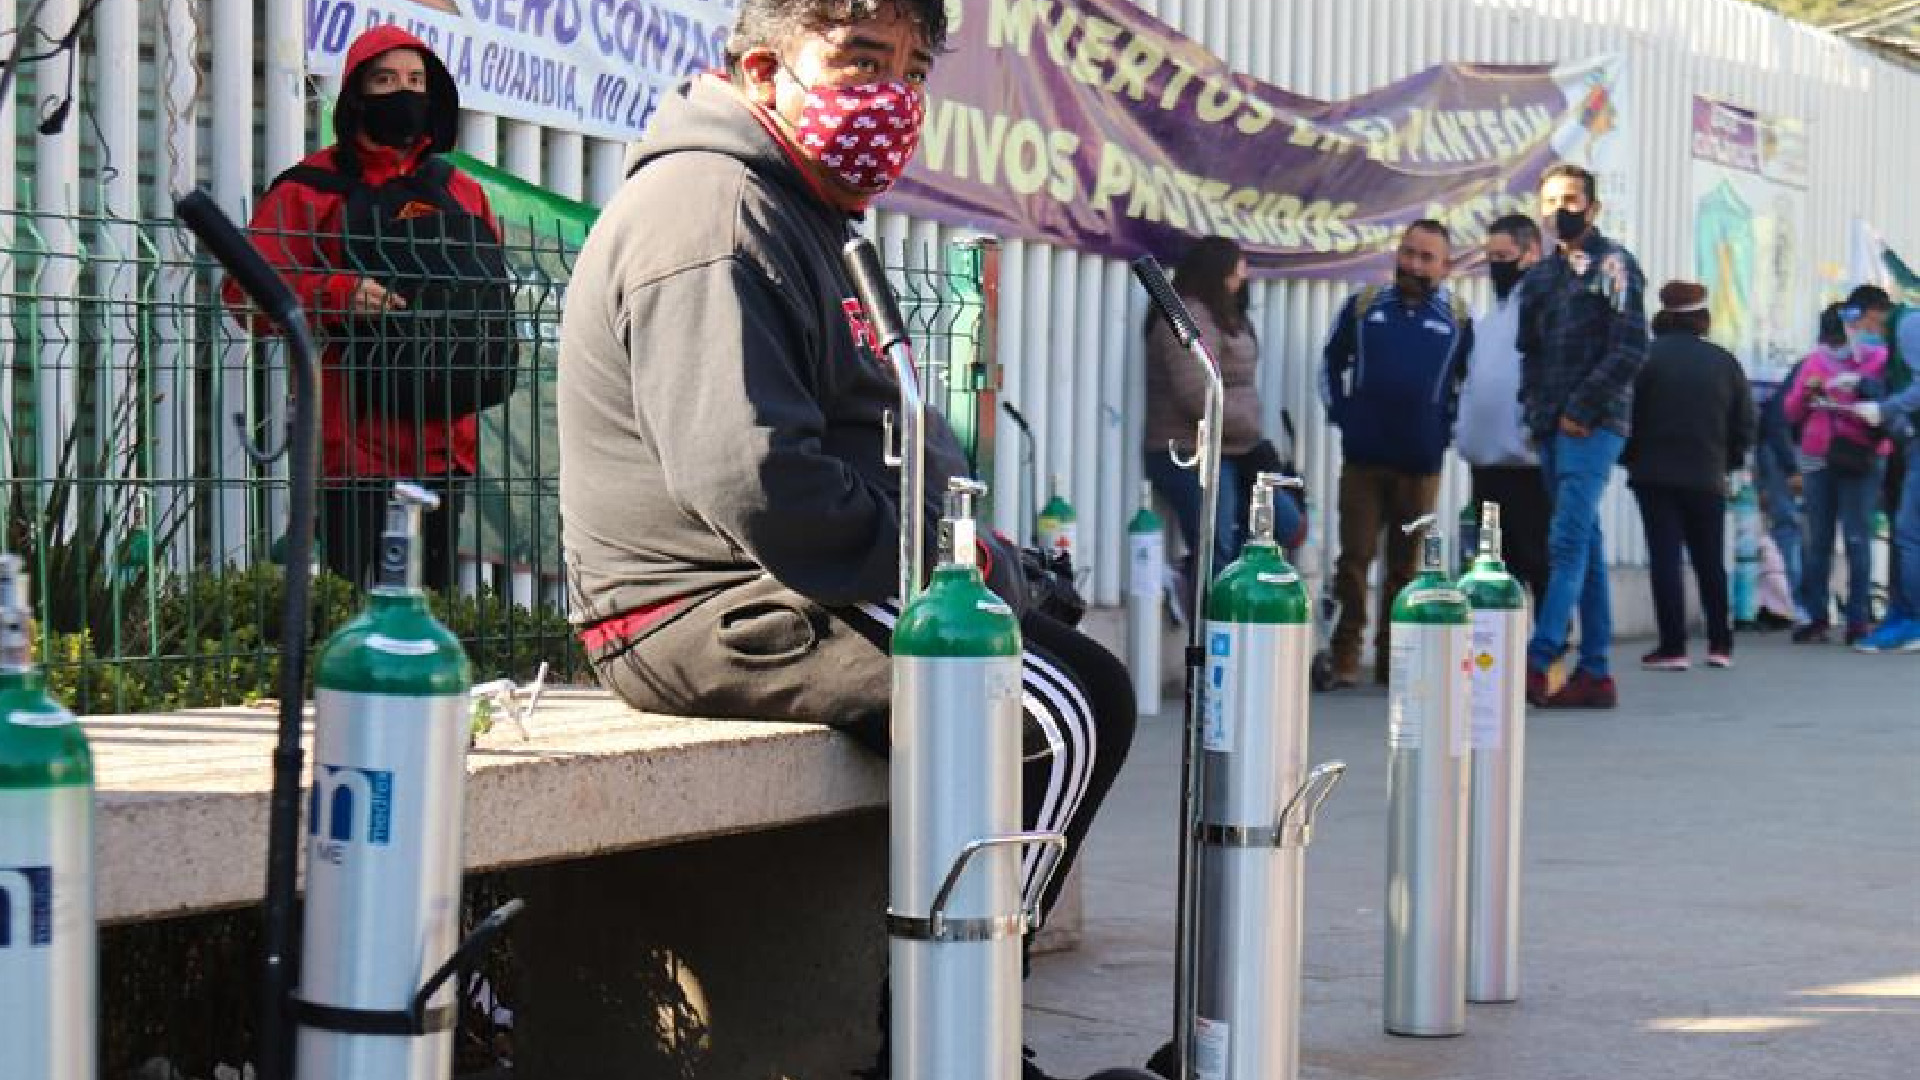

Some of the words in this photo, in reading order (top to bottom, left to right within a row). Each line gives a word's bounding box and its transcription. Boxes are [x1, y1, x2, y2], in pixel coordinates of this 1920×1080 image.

[480, 41, 584, 121] GUARDIA,
[591, 73, 626, 124] NO
[988, 0, 1275, 134] MUERTOS
[924, 95, 1079, 202] VIVOS
[1091, 141, 1358, 253] PROTEGIDOS
